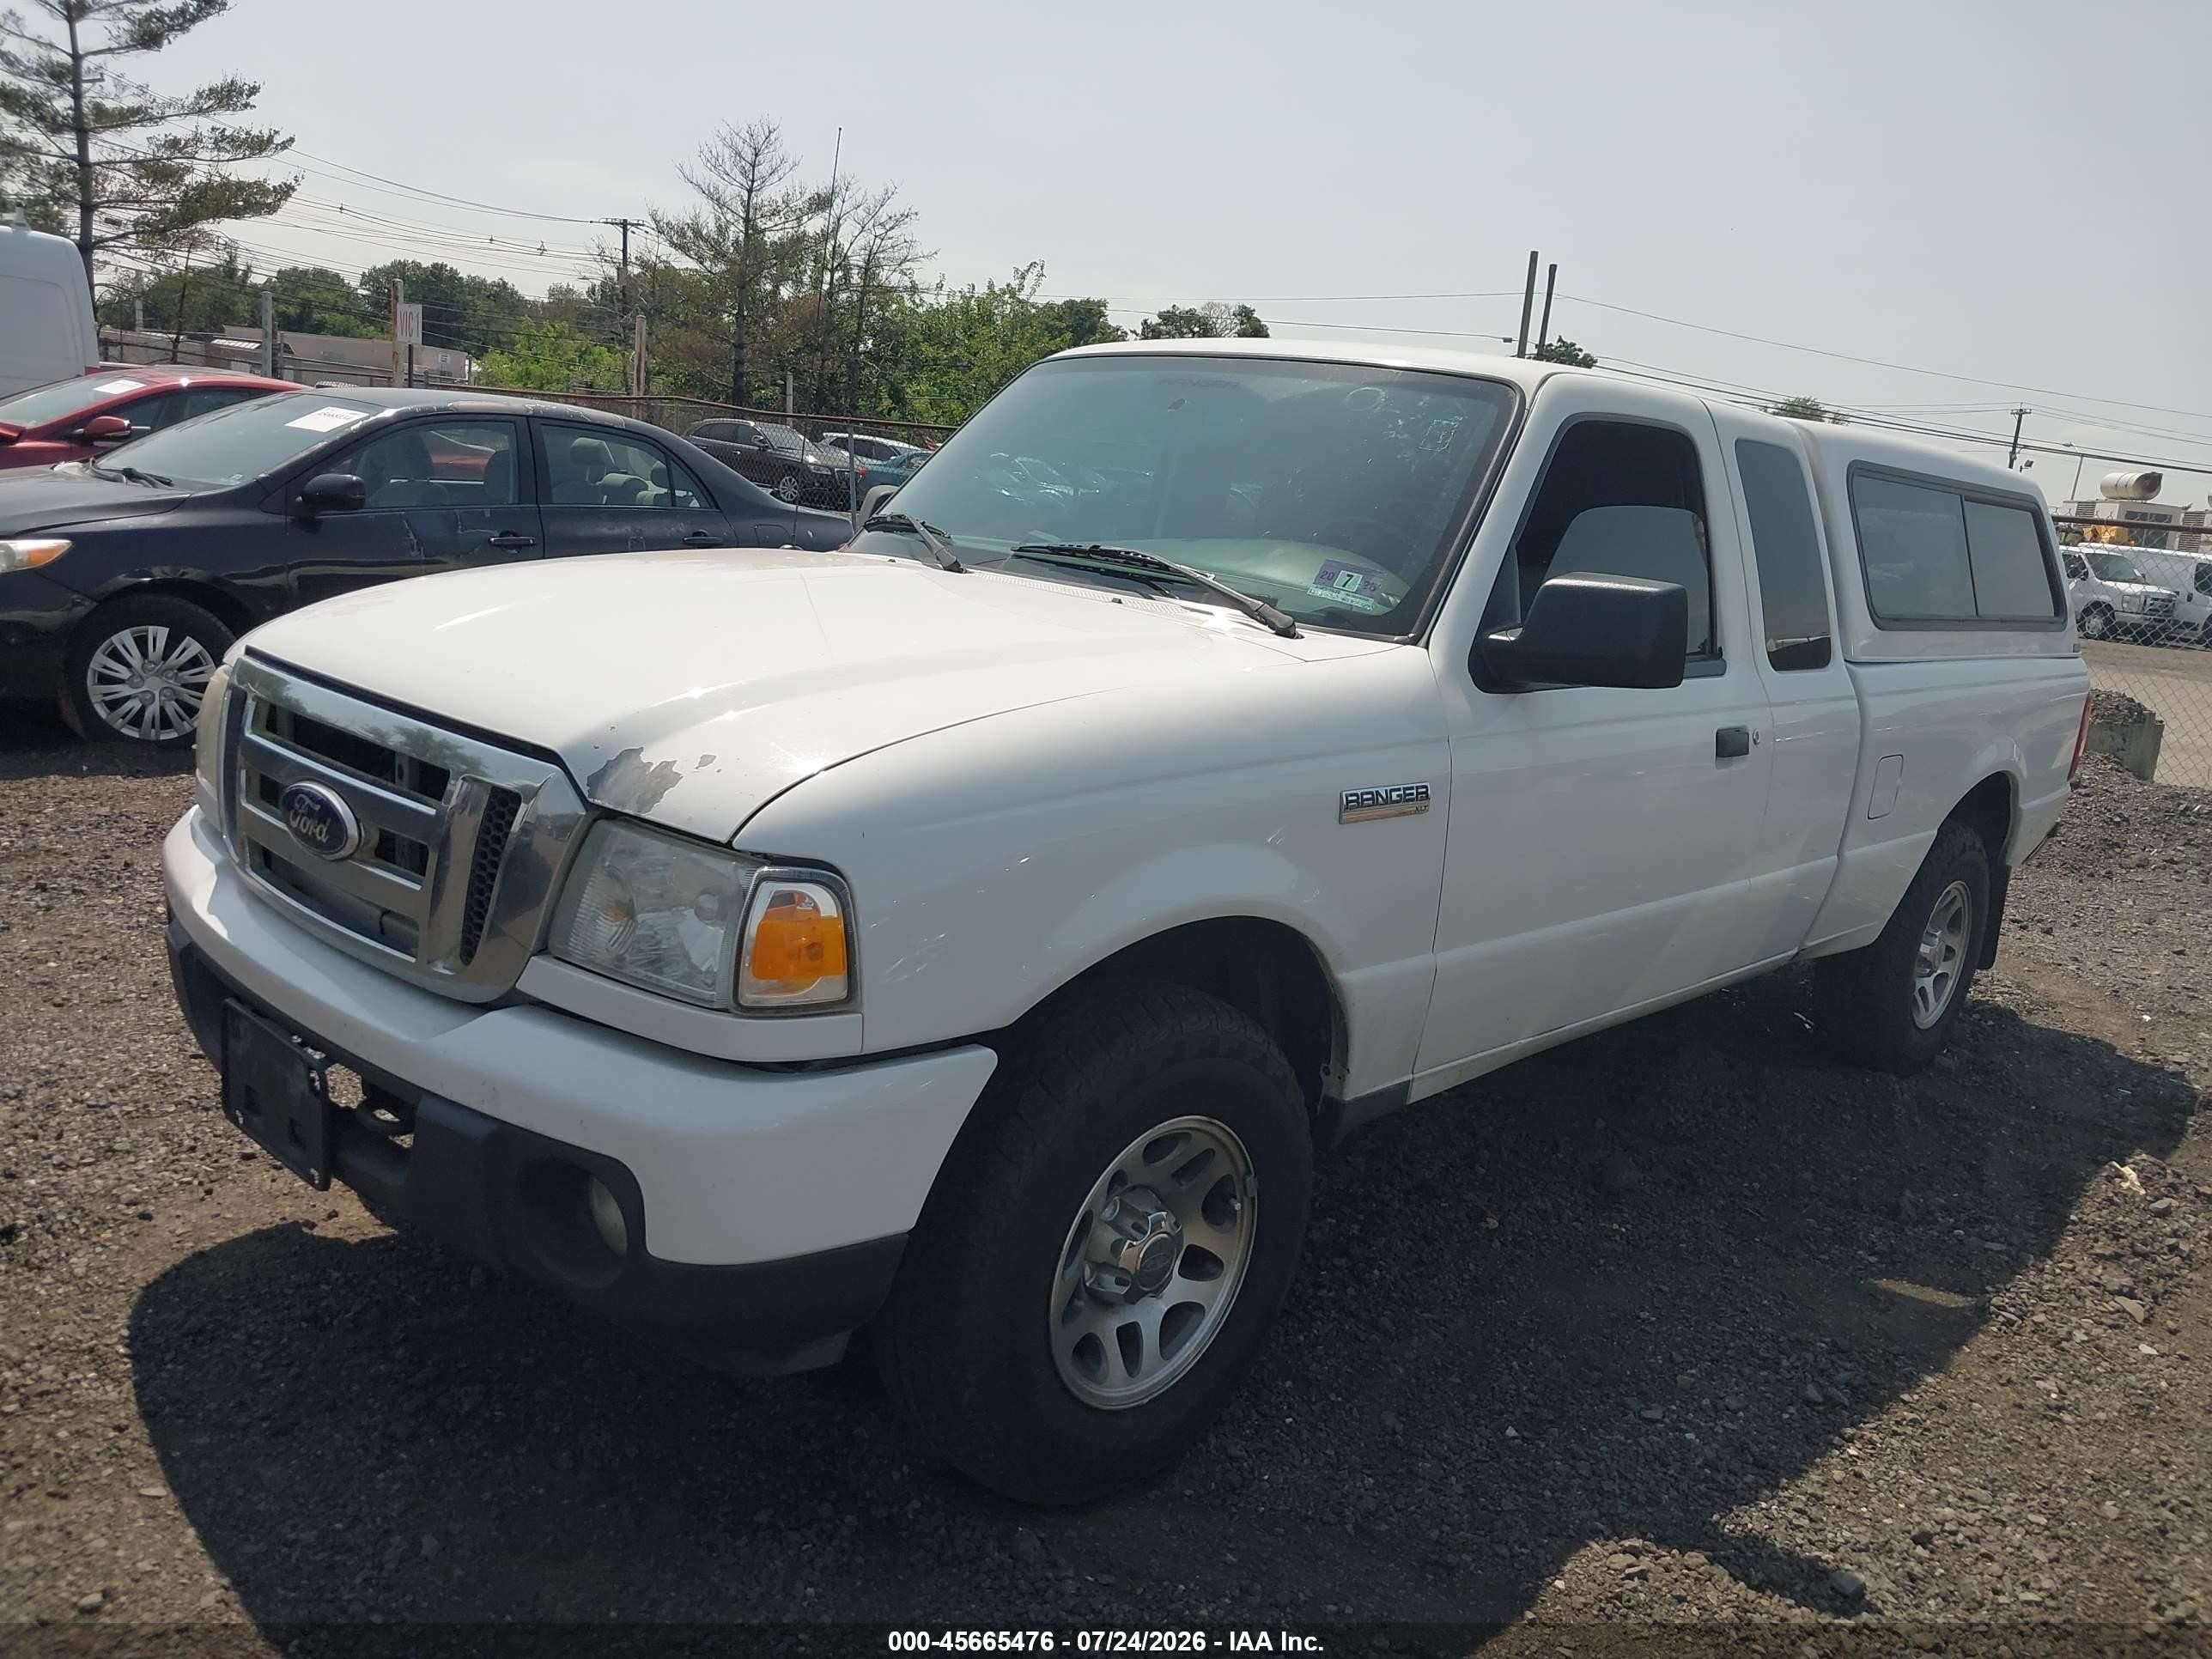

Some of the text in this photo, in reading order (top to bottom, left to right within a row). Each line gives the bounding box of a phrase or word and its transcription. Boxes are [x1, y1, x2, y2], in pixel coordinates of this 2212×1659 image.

[399, 311, 413, 337] VIC
[1320, 570, 1334, 581] 20
[1343, 574, 1354, 587] 7
[1344, 784, 1430, 811] RANGER
[289, 793, 331, 843] Ford
